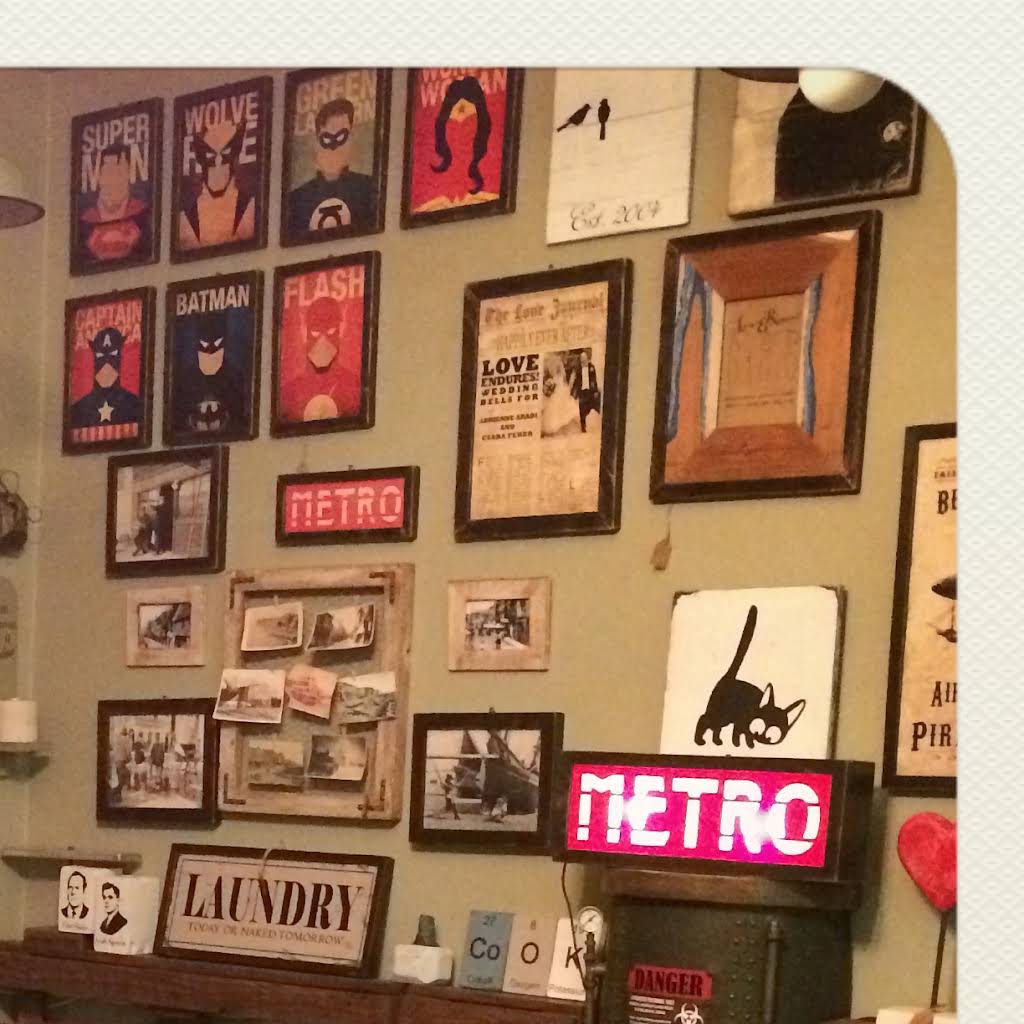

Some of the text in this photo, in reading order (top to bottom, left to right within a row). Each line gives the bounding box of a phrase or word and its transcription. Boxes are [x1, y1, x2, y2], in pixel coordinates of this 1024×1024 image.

[185, 92, 257, 135] WOLVE
[82, 113, 149, 152] SUPER
[183, 122, 257, 176] RE
[81, 143, 149, 193] MN
[176, 284, 250, 316] BATMAN
[284, 265, 365, 309] FLASH
[485, 308, 508, 326] The
[515, 304, 544, 324] Love
[482, 354, 539, 376] LOVE
[481, 372, 539, 387] ENDURES!
[482, 383, 538, 396] WEDDING
[480, 394, 538, 406] BELLS FOR
[291, 485, 402, 527] METRO
[911, 722, 957, 752] PIR
[576, 773, 822, 857] METRO
[183, 874, 363, 932] LAUNDRY
[188, 922, 345, 945] TODAY OR NAKED TOMORROW
[483, 915, 497, 927] 27
[470, 937, 500, 960] Co
[521, 942, 539, 964] O
[565, 946, 583, 969] K
[634, 969, 703, 997] DANGER
